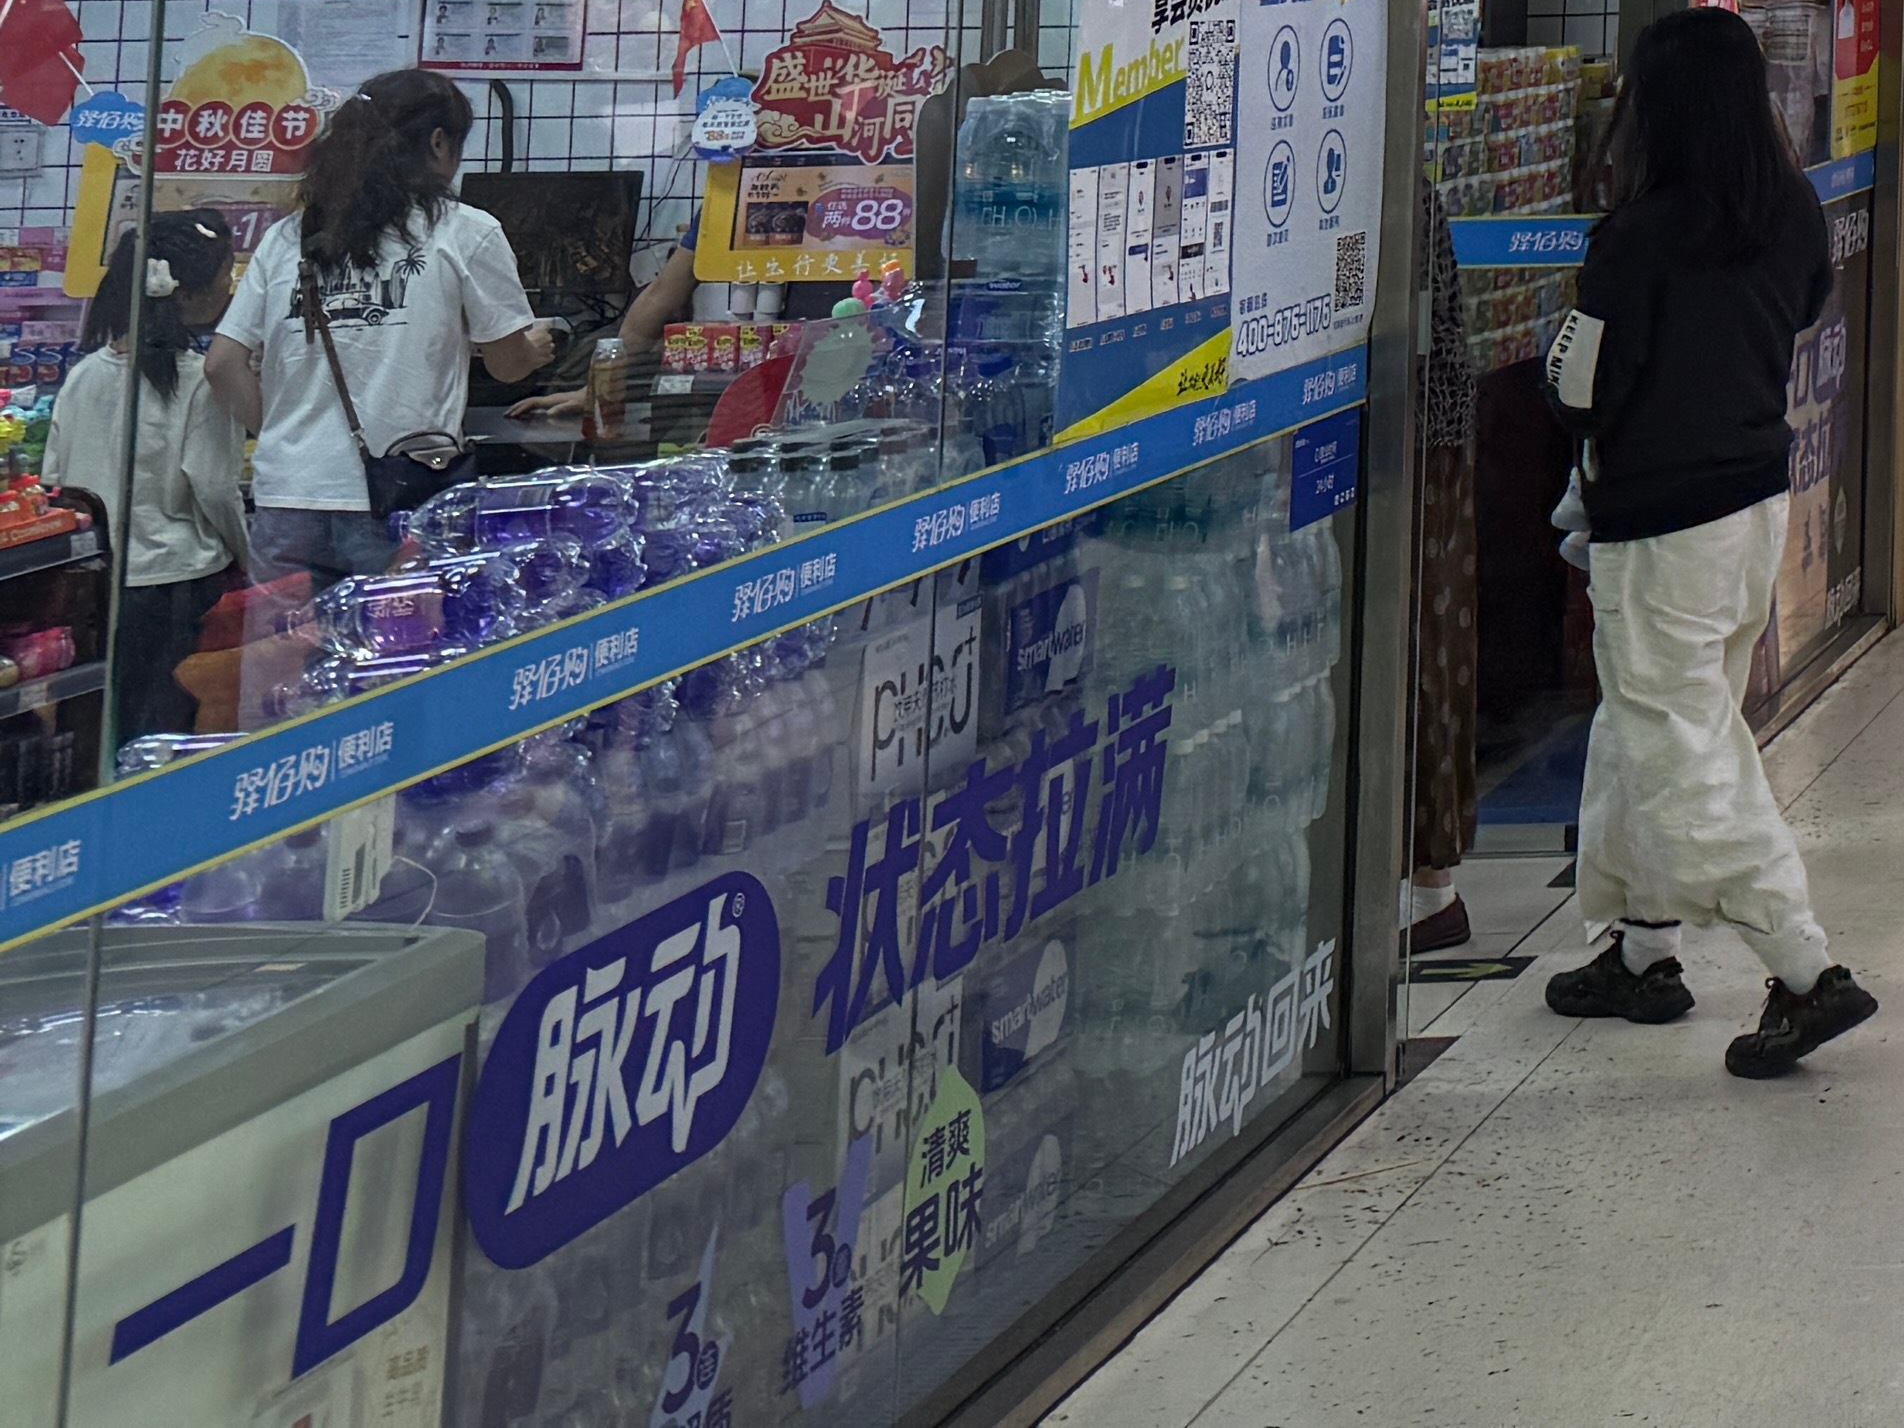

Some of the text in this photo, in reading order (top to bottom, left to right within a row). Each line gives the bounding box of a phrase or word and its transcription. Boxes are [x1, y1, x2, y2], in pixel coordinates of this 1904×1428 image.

[763, 46, 908, 103] 盛世华诞
[1069, 33, 1188, 125] Member
[156, 108, 311, 140] 中秋佳节
[851, 199, 903, 231] 88
[1556, 313, 1581, 355] KEEP
[1337, 364, 1358, 390] 便利店
[1233, 400, 1257, 426] 便利店
[1112, 442, 1140, 469] 便利店
[969, 493, 1002, 524] 便利店
[799, 552, 838, 590] 便利店
[594, 627, 640, 668] 便利店
[1016, 621, 1087, 672] smartwater
[336, 720, 395, 771] 便利店
[8, 838, 82, 892] 便利店
[812, 665, 1178, 1058] 状态拉满
[991, 971, 1069, 1045] smartwater
[504, 892, 742, 1217] 脉动
[1168, 937, 1338, 1168] 脉动回来
[920, 1108, 972, 1190] 清爽
[899, 1162, 985, 1301] 果味
[781, 1284, 866, 1397] 维生素
